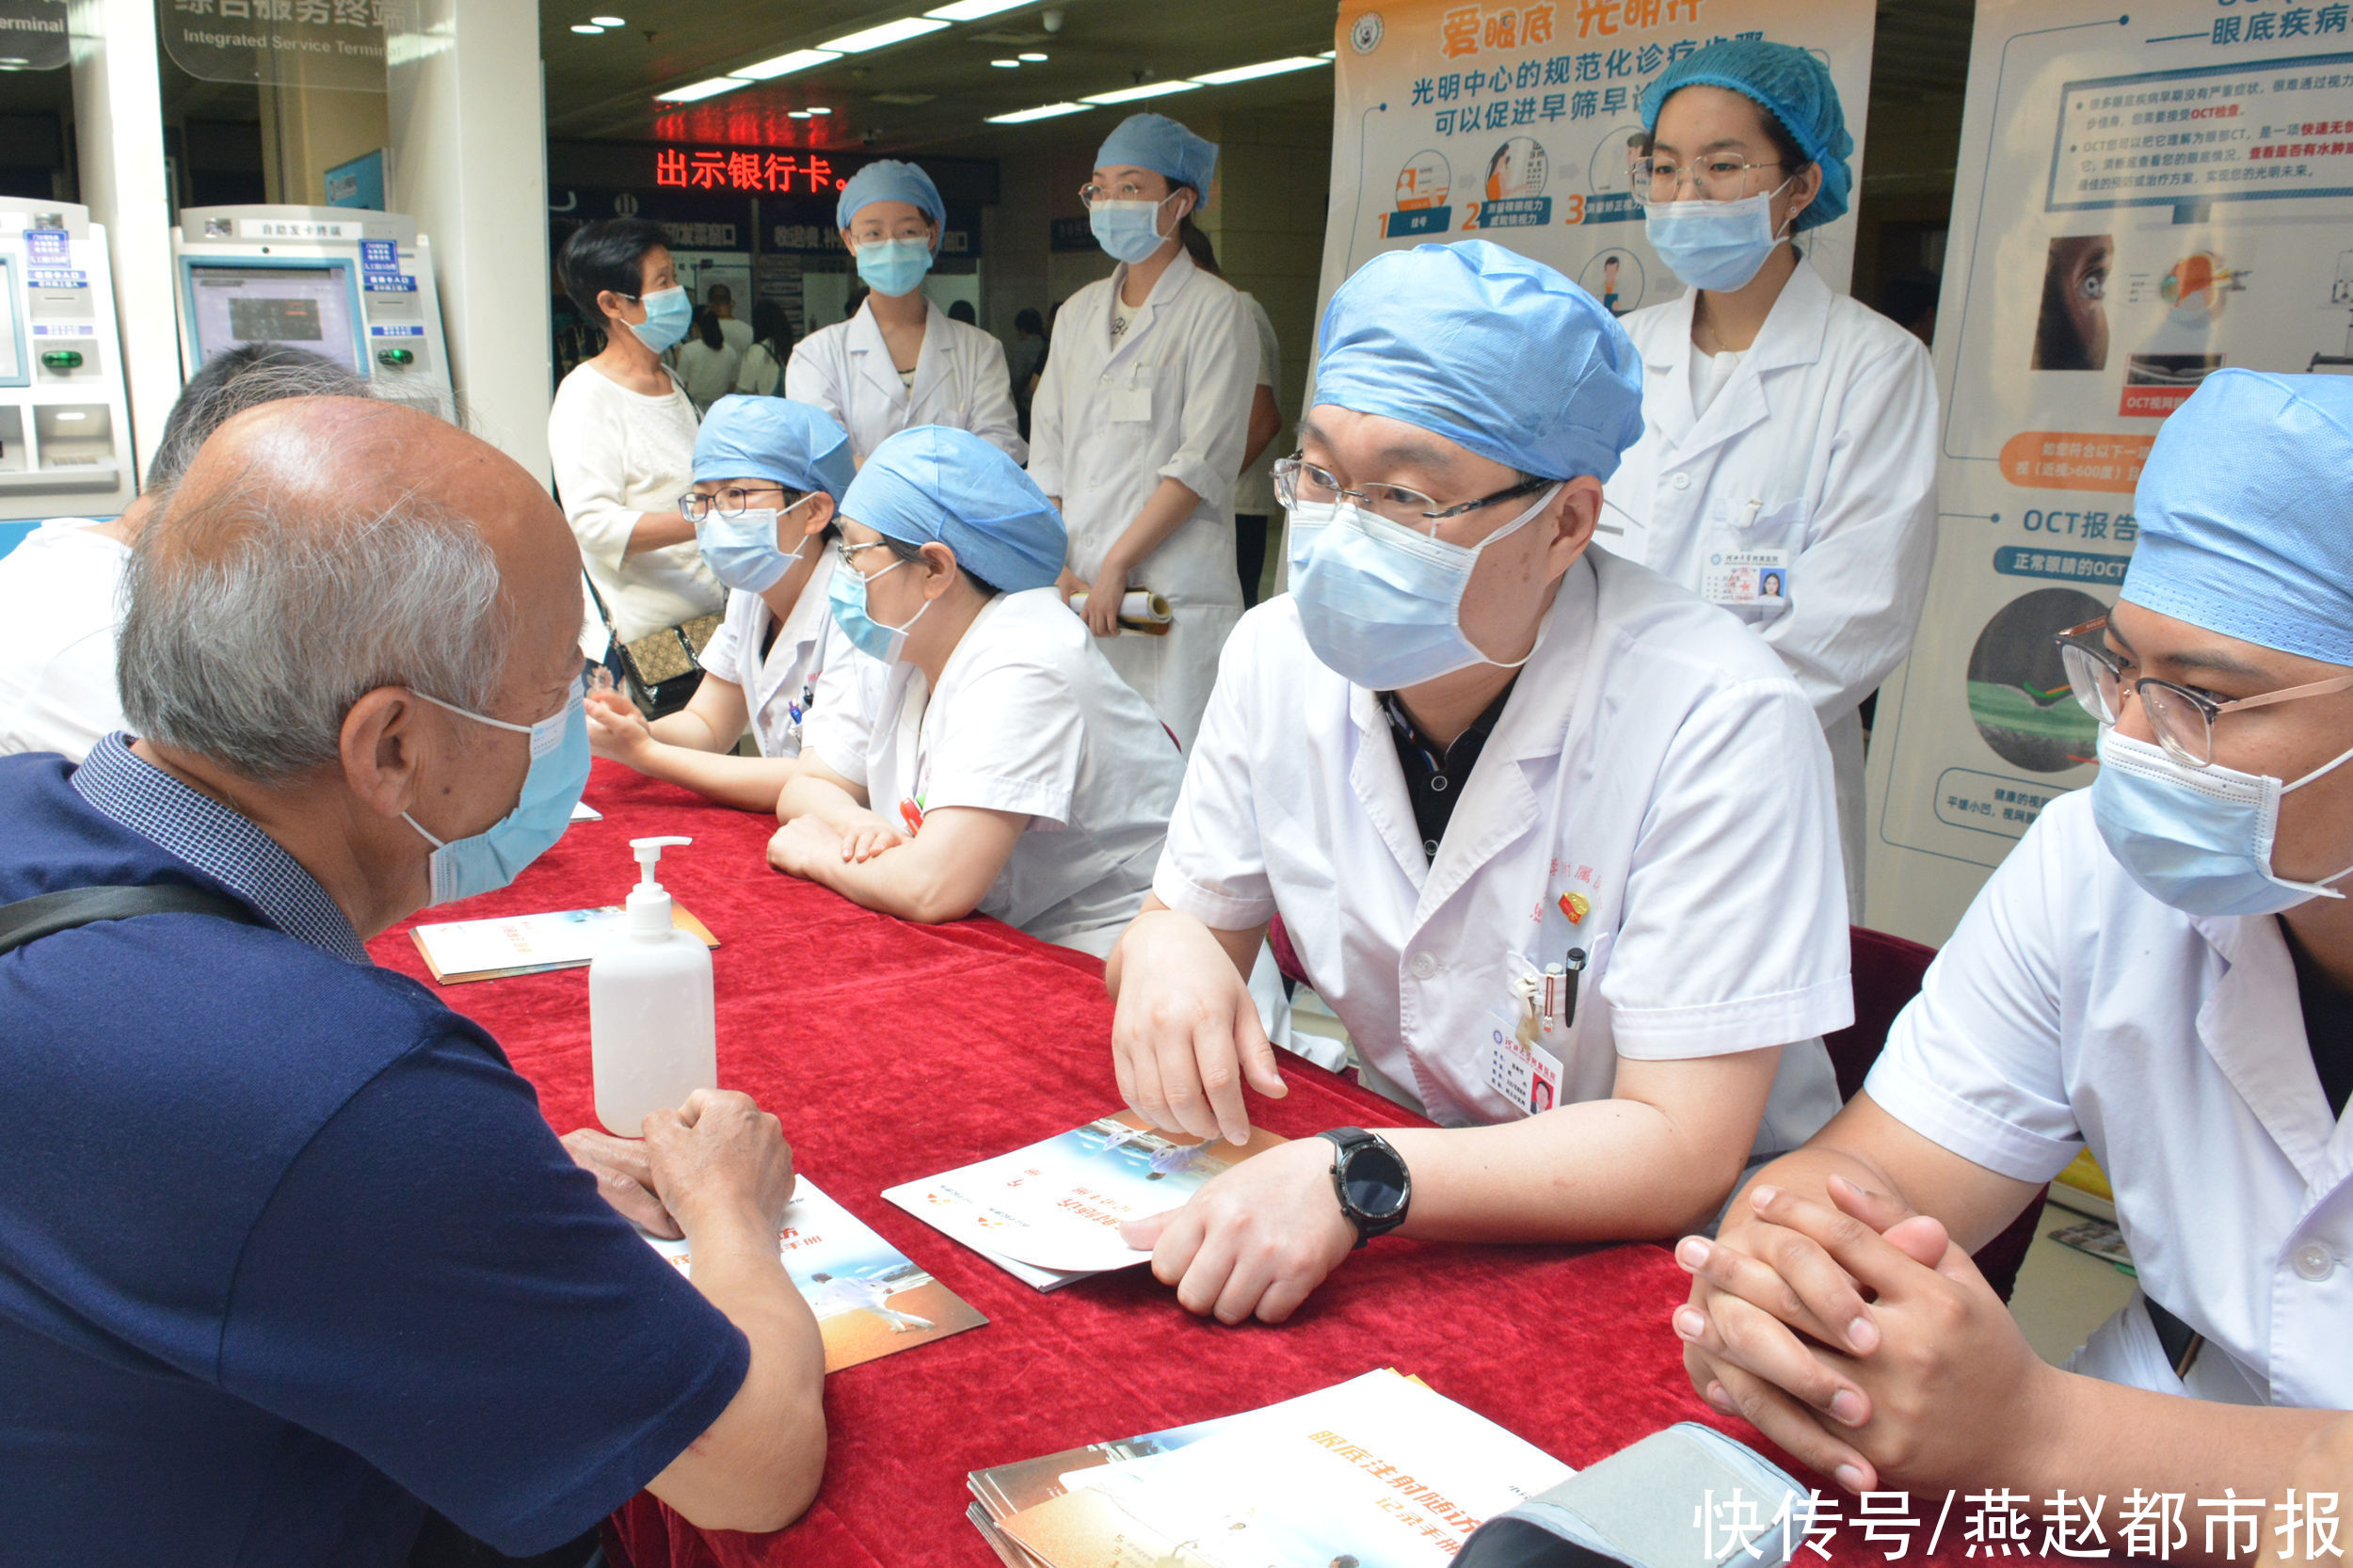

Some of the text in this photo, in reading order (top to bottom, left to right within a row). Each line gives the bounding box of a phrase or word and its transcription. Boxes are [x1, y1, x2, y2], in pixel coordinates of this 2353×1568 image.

[184, 28, 402, 56] Integrated Service Terminal
[1442, 4, 1554, 59] 爱眼底
[657, 150, 848, 193] 出示银行卡。
[1462, 202, 1480, 231] 2
[1565, 194, 1584, 225] 3
[1379, 213, 1388, 239] 1
[2024, 509, 2138, 541] OCT报告
